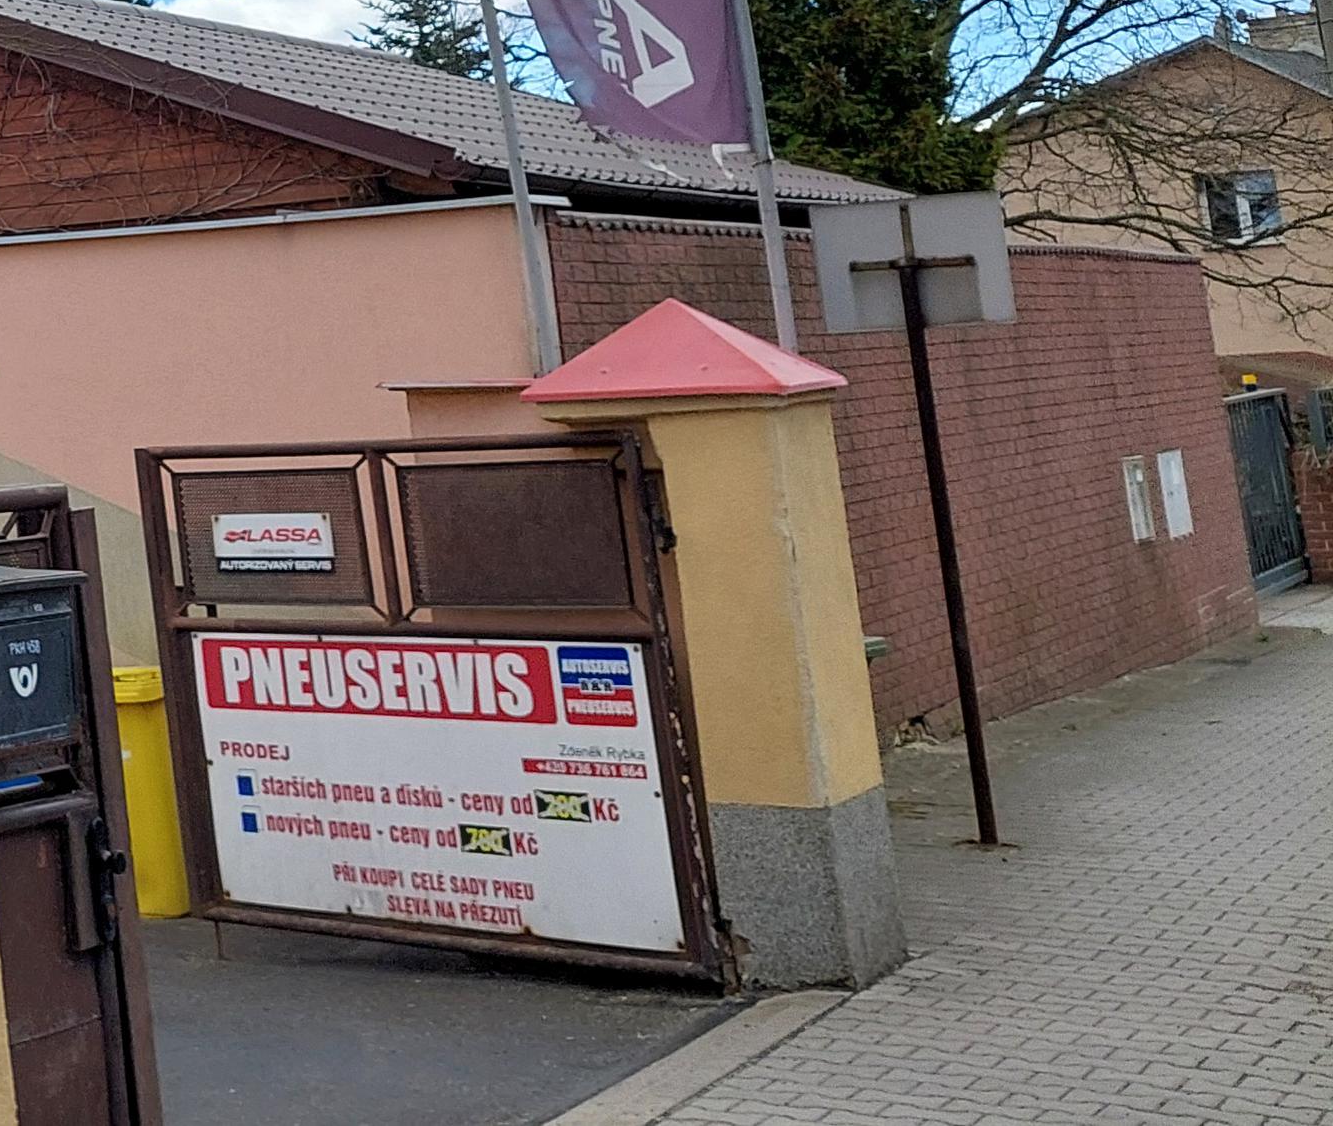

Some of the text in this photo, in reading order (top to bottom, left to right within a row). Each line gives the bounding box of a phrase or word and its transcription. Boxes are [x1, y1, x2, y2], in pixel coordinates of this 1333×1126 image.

[246, 528, 322, 542] LASSA
[294, 559, 332, 571] SERVIS
[220, 646, 533, 718] PNEUSERVIS
[220, 740, 290, 761] PRODEJ
[261, 775, 327, 799] starších
[332, 783, 375, 803] pneu
[380, 786, 391, 804] a
[461, 792, 504, 816] ceny
[511, 794, 533, 815] od
[593, 797, 620, 822] Kč
[266, 813, 324, 837] nových
[328, 819, 371, 840] pneu
[389, 824, 430, 848] ceny
[436, 827, 458, 848] od
[513, 831, 539, 856] Kč
[359, 865, 404, 888] KOUPI
[411, 869, 446, 892] CELÉ
[450, 876, 488, 897] SADY
[492, 879, 535, 901] PNEU
[386, 894, 523, 927] SLEVA NA PŘEZUTÍ
